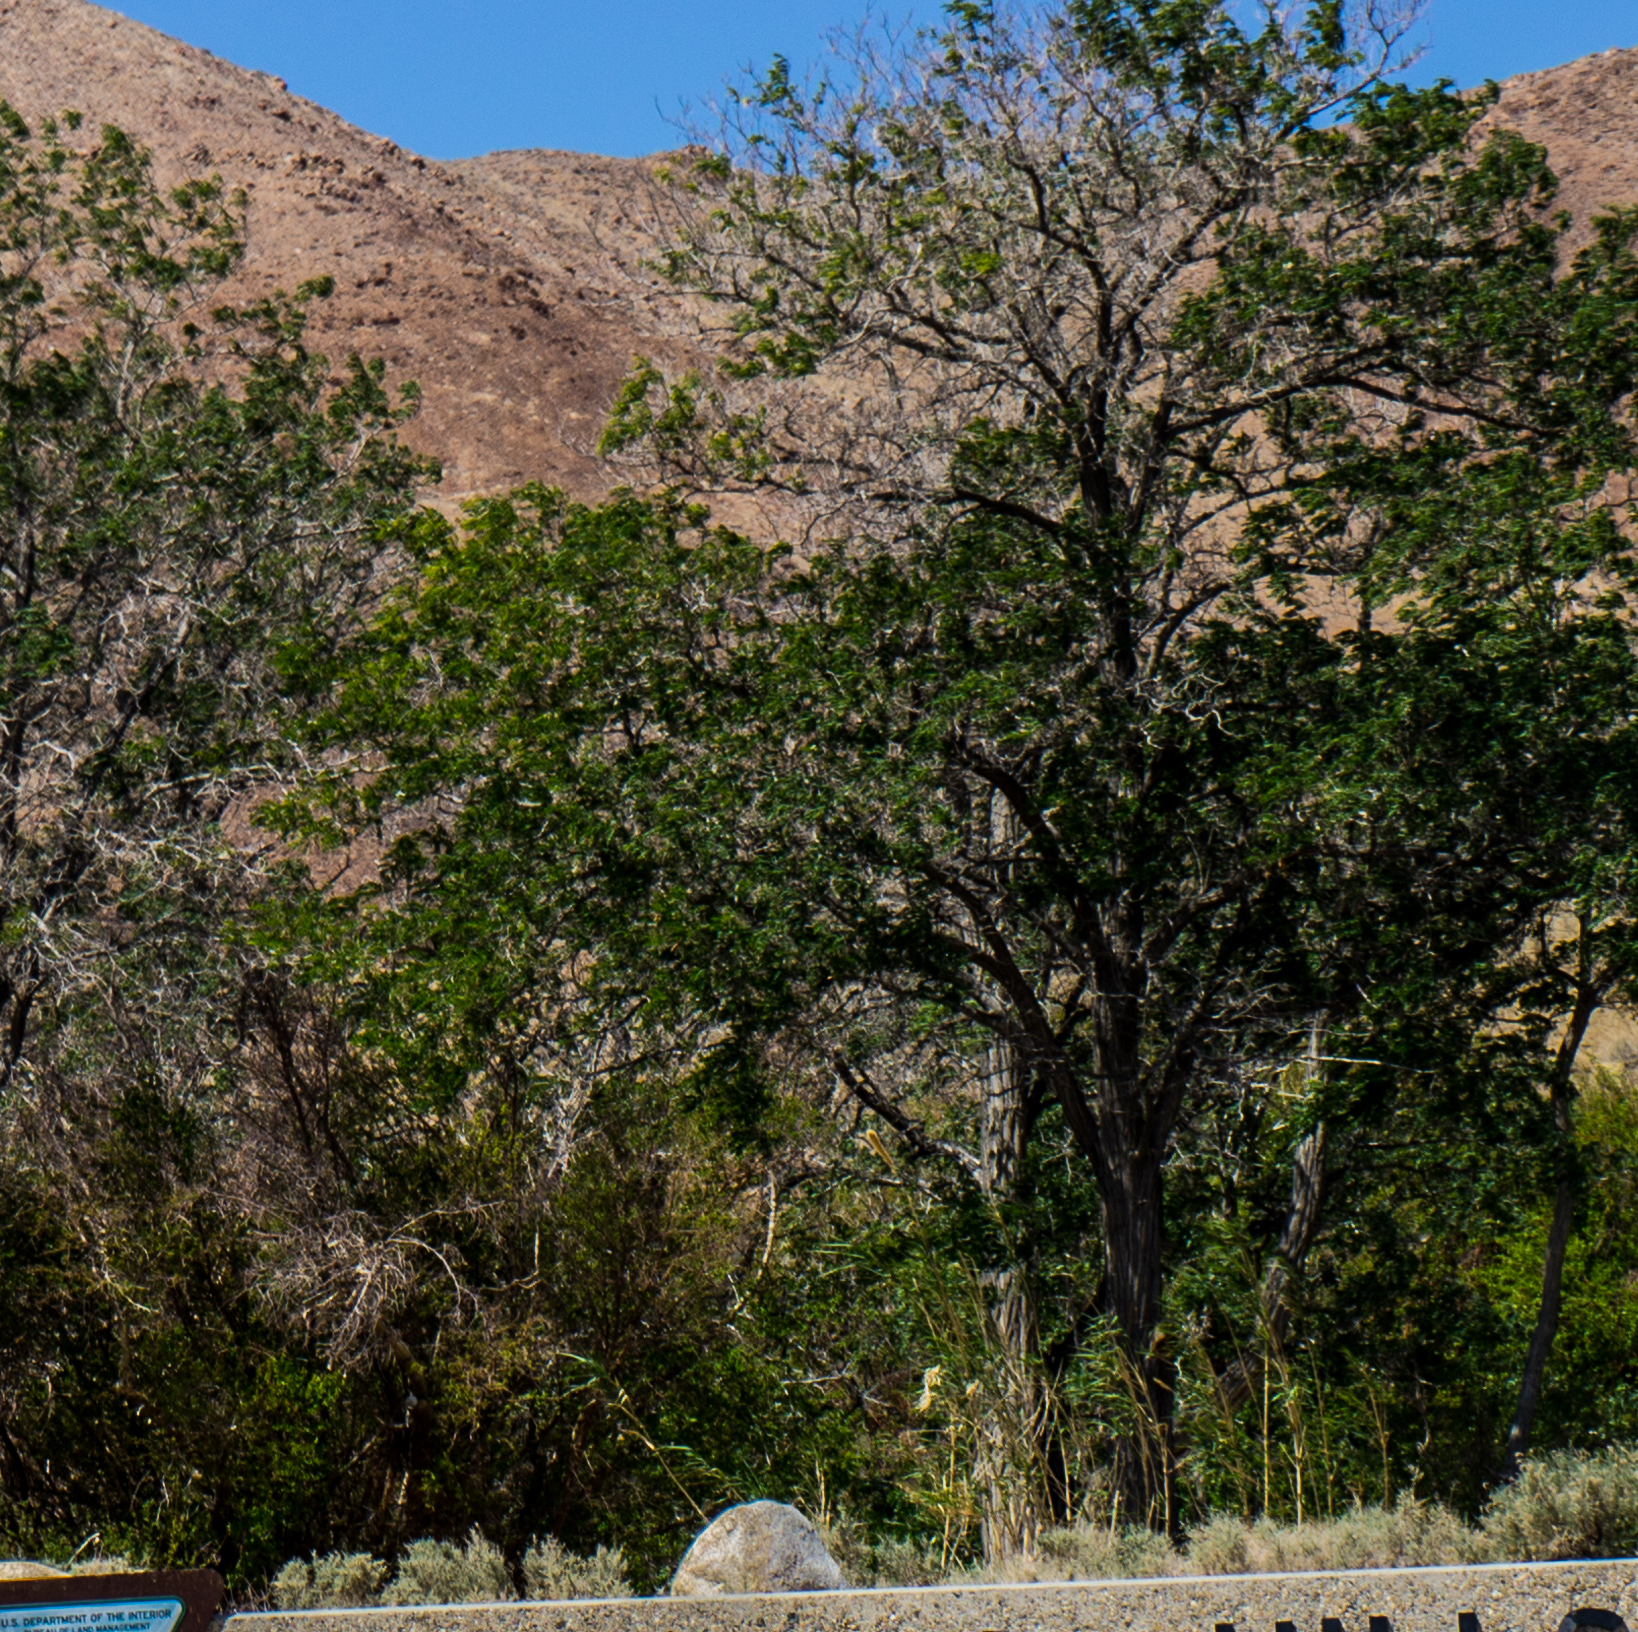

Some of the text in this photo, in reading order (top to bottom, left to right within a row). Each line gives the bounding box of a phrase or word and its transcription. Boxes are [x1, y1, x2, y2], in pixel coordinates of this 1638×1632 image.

[23, 1614, 87, 1626] DEPARTMENT
[90, 1613, 102, 1623] OF
[106, 1612, 125, 1621] THE
[128, 1609, 171, 1619] INTERIOR
[96, 1622, 151, 1632] MANAGEMENT
